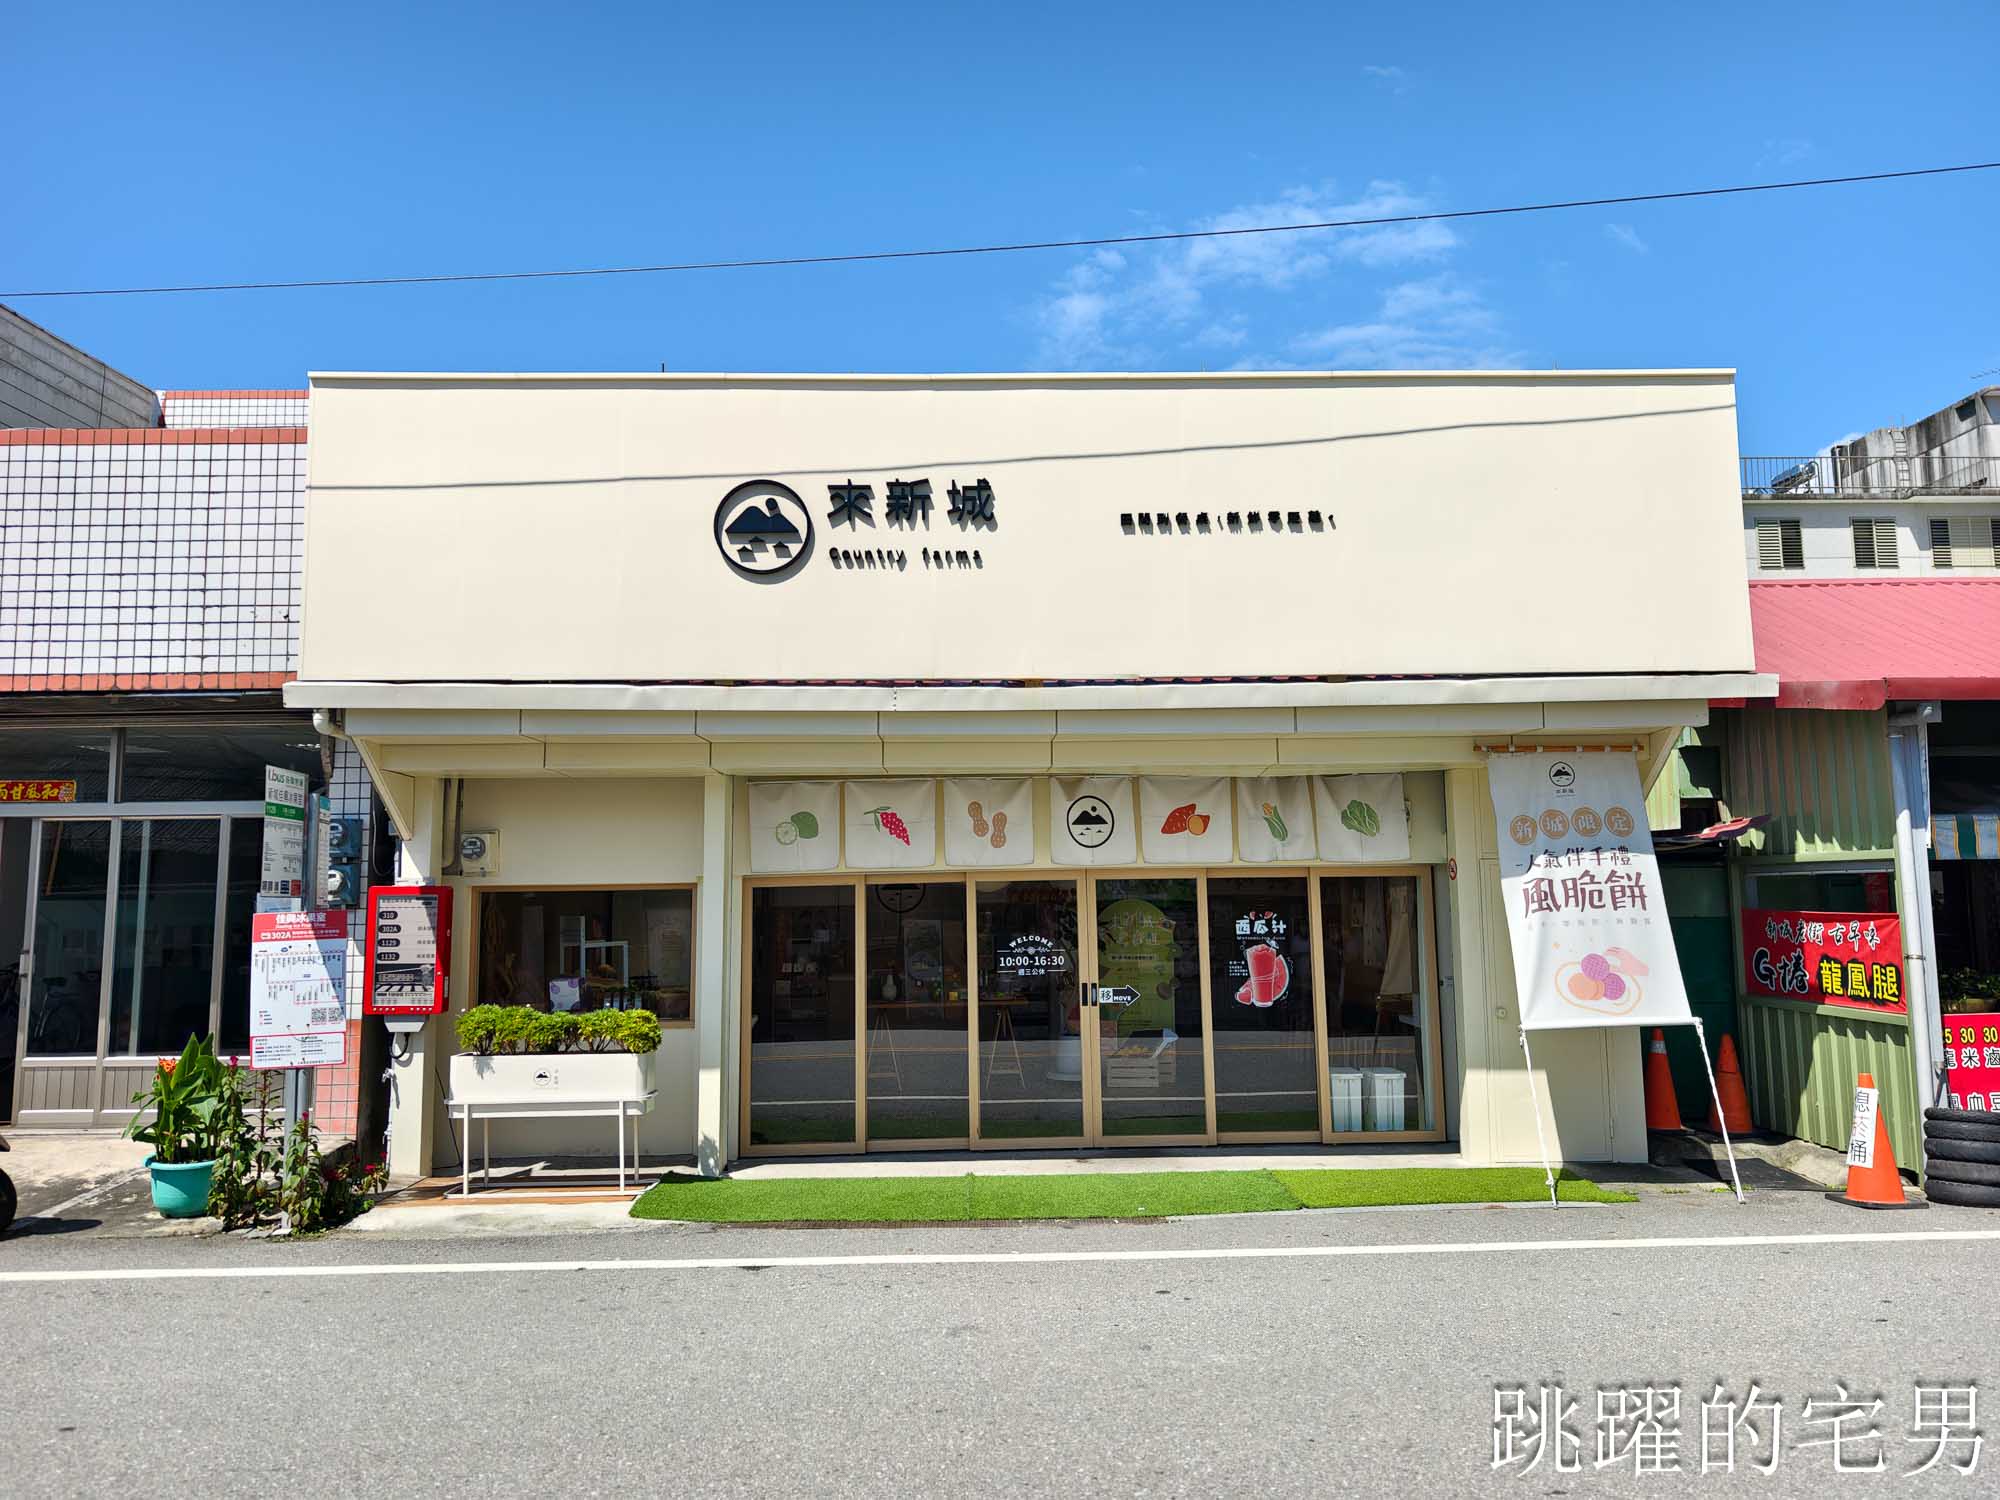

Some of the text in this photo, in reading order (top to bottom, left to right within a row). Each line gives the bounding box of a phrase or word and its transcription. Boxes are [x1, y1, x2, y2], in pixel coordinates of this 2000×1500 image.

[827, 478, 995, 523] 來新城
[829, 547, 904, 565] Country
[1515, 814, 1629, 839] 新城限定
[1523, 869, 1648, 918] 風脆餅
[271, 931, 292, 939] 302A
[1236, 919, 1287, 935] 西瓜汁
[1828, 920, 1881, 952] 古早味
[1008, 935, 1054, 948] WELCOME
[999, 955, 1065, 967] 10:00-16:30
[1820, 960, 1899, 1002] 龍鳳腿
[1960, 1027, 1975, 1044] 30
[1984, 1027, 1999, 1043] 30
